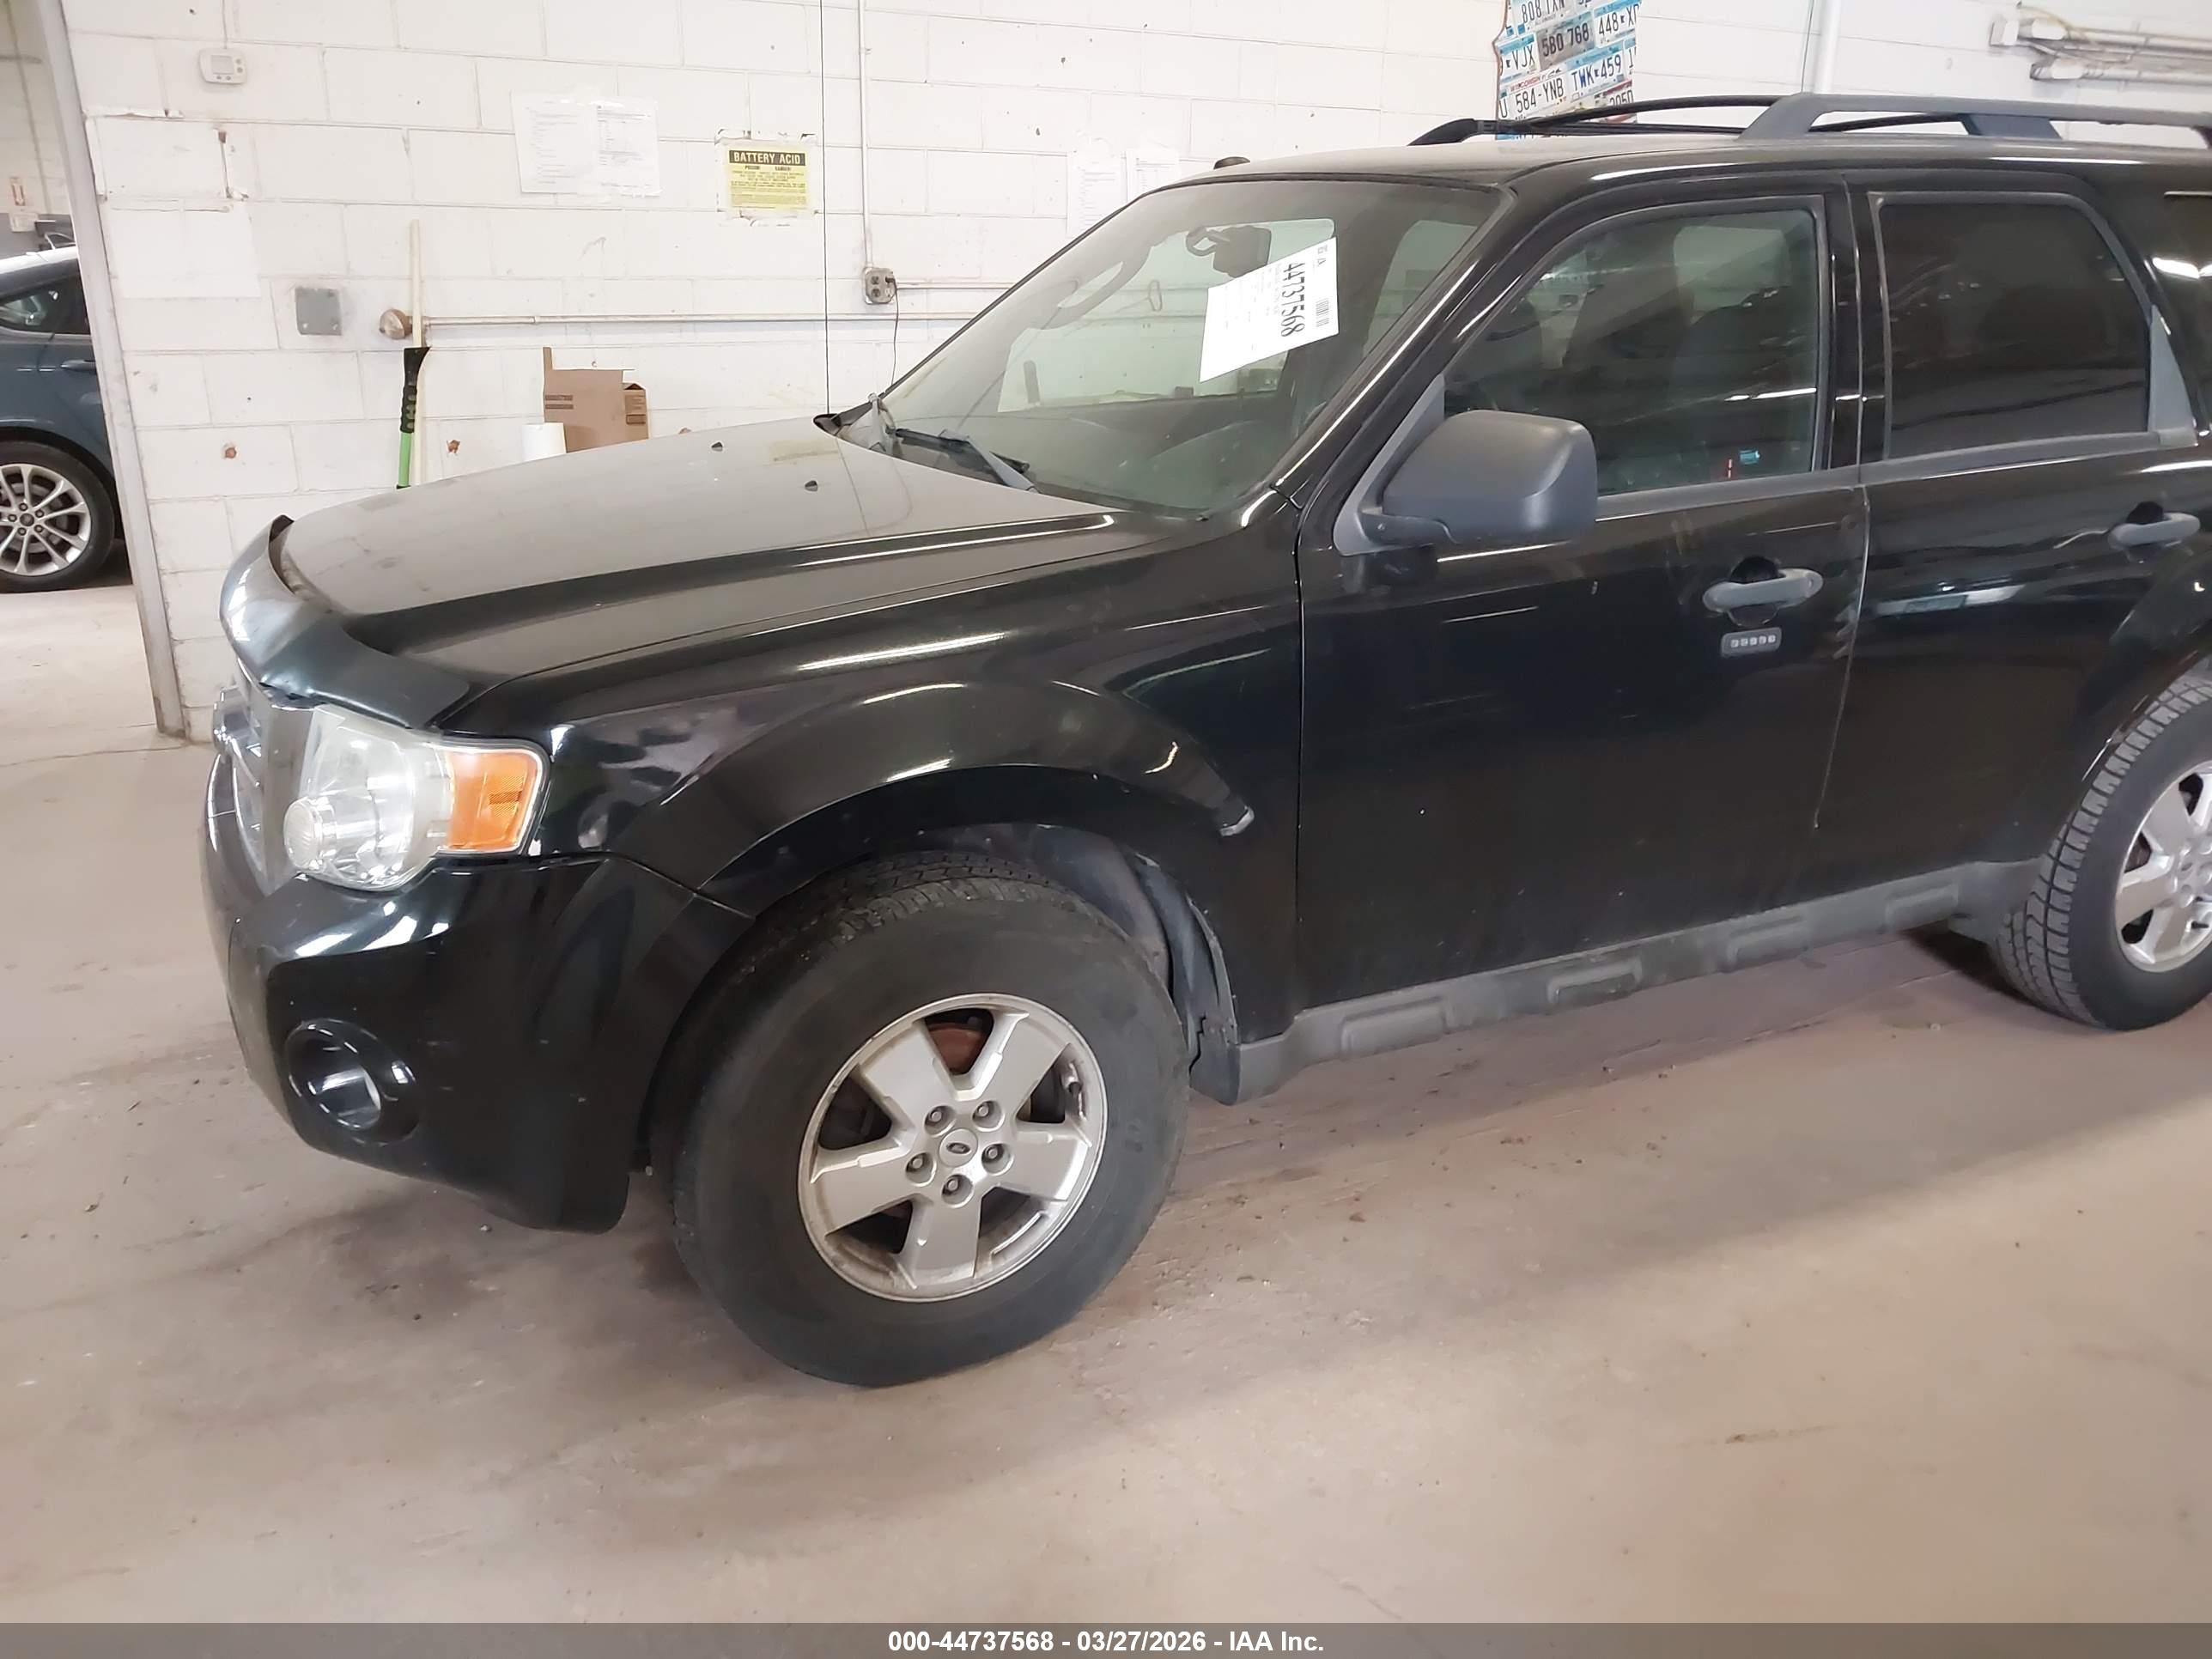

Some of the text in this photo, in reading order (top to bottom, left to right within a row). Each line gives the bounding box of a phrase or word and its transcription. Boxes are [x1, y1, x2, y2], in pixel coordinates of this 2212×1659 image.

[1567, 22, 1589, 46] 768
[1598, 11, 1619, 36] 448
[1512, 46, 1535, 70] VJX
[1571, 64, 1595, 91] TWK
[1601, 54, 1621, 79] 459
[1515, 77, 1565, 113] 584-YNB
[733, 152, 801, 165] BATTERY ACID
[1281, 262, 1306, 337] 44737568
